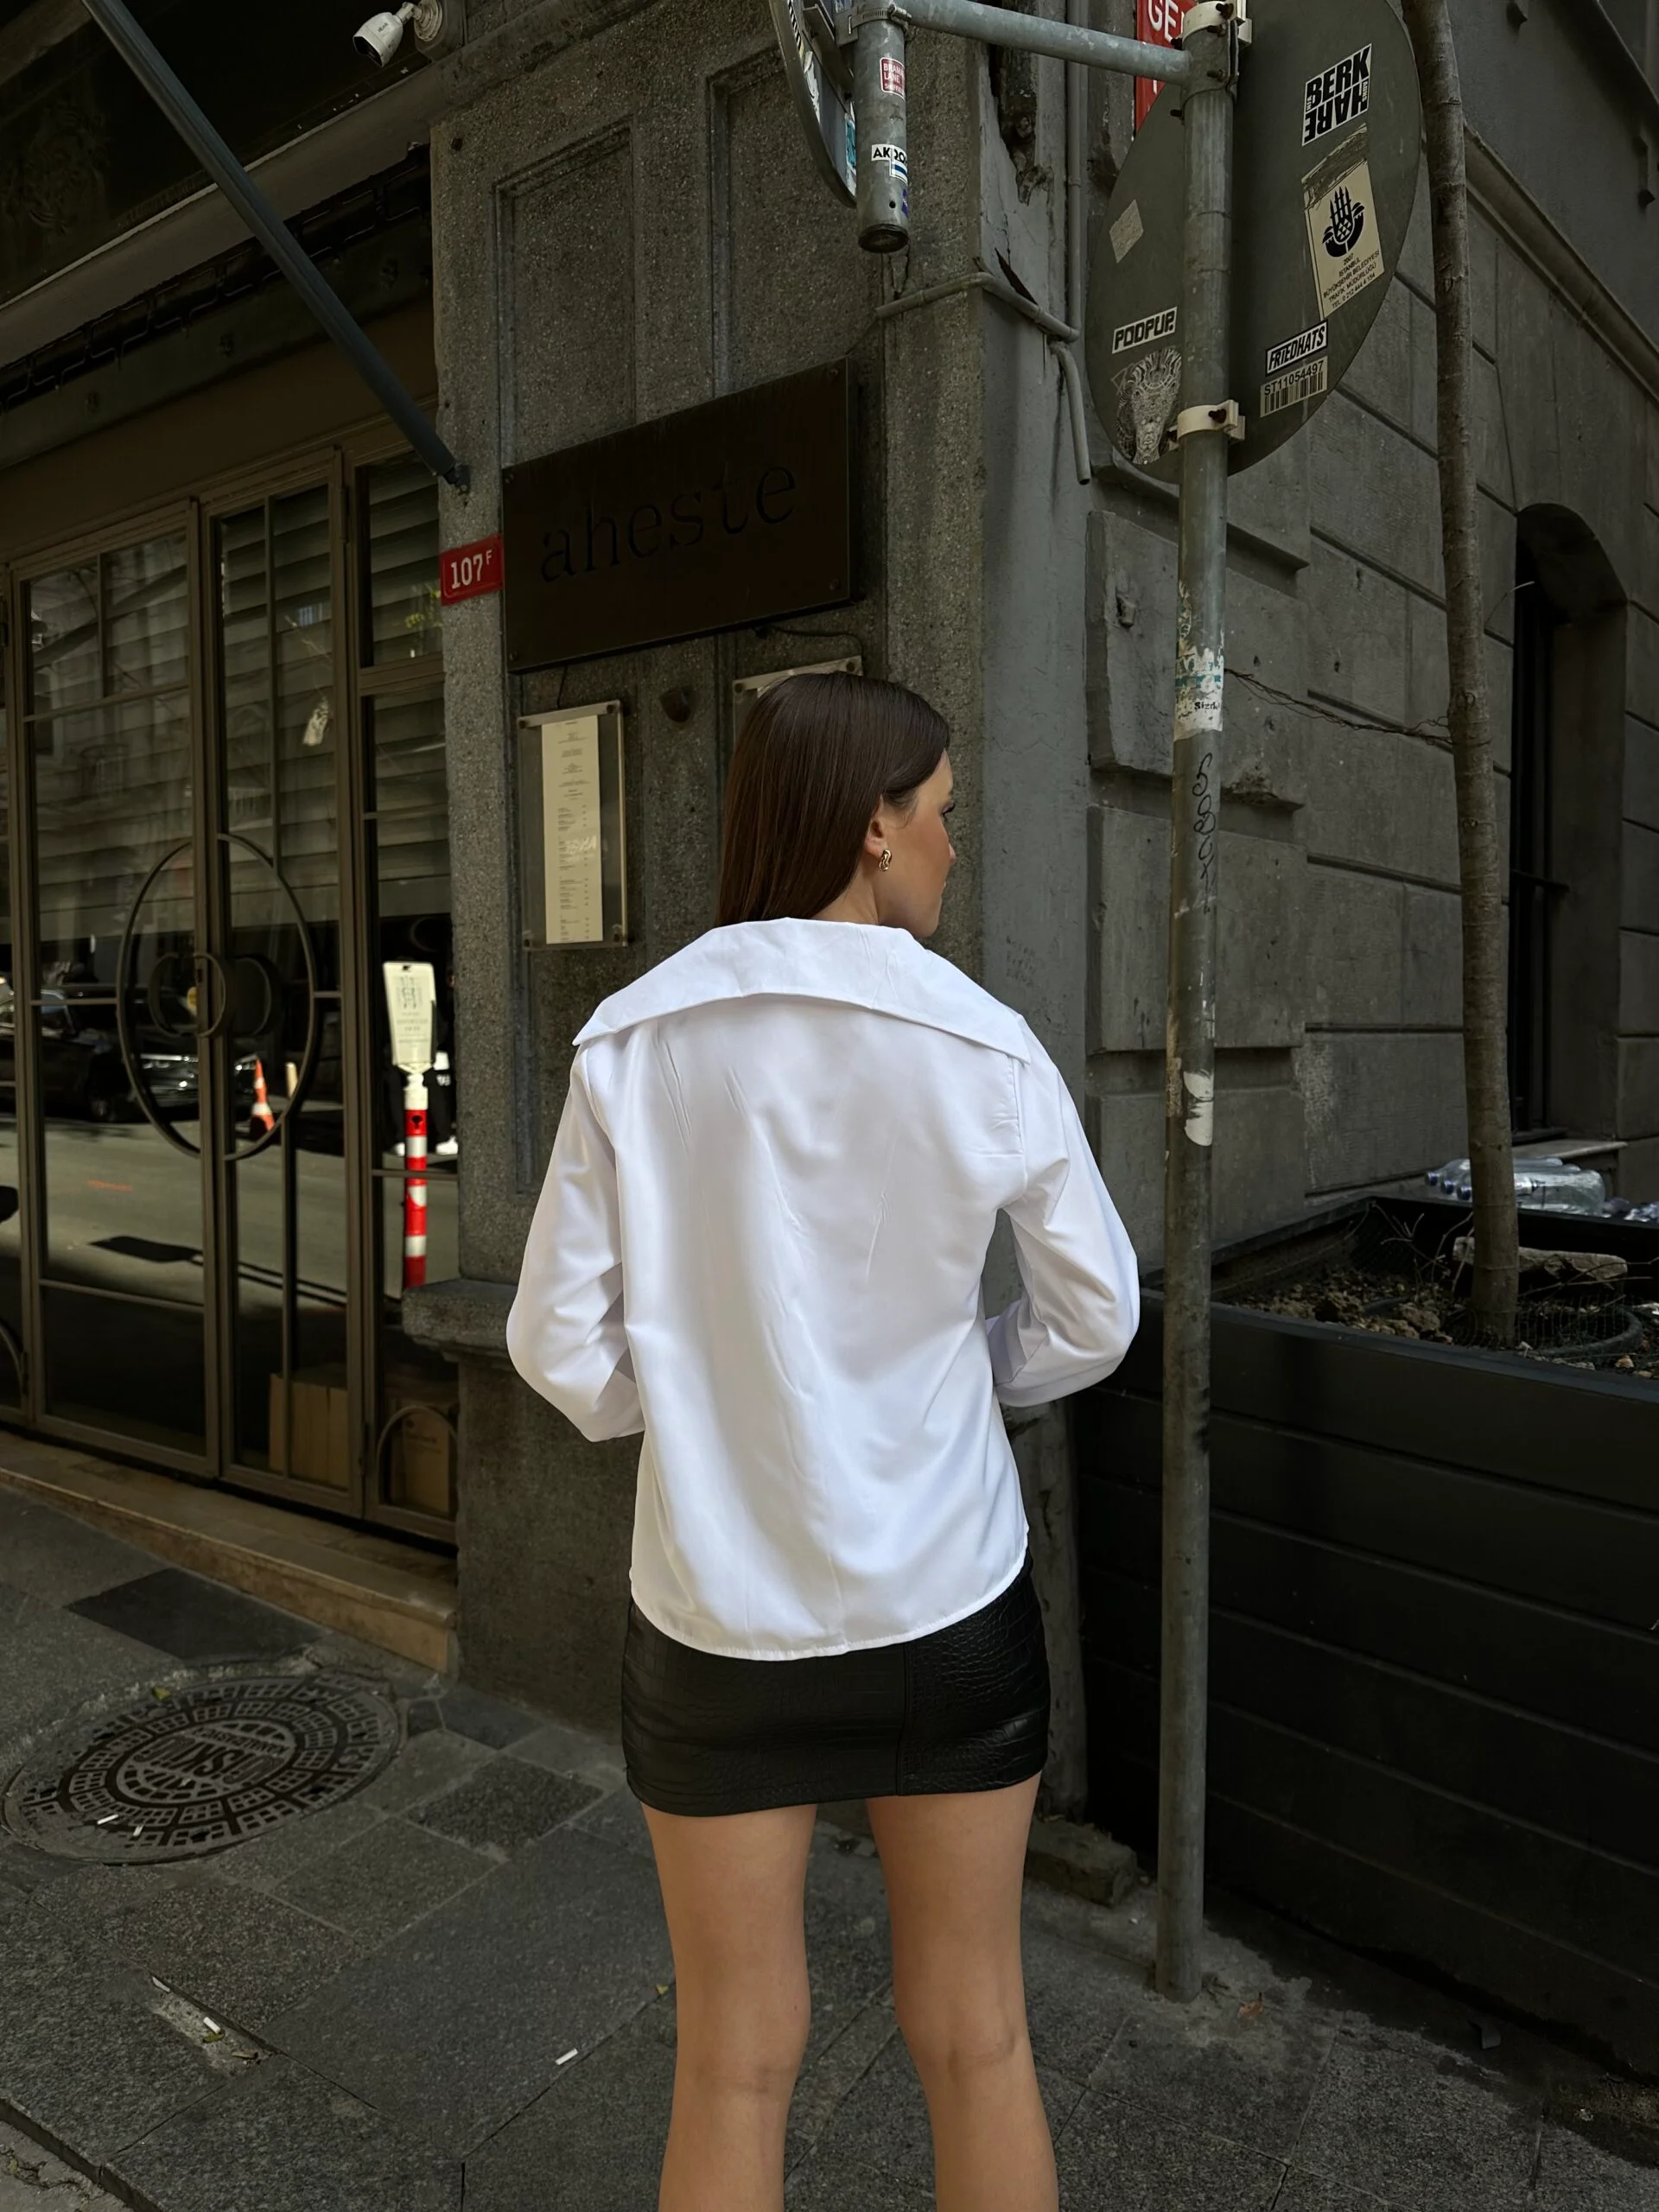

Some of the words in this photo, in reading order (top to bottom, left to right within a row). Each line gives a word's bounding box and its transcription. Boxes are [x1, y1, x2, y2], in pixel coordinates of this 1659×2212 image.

[1304, 78, 1369, 143] HARE
[1306, 46, 1370, 111] BERK
[1264, 360, 1324, 396] ST11054497
[1269, 325, 1325, 371] FRIEDHATS
[540, 461, 797, 582] aheste
